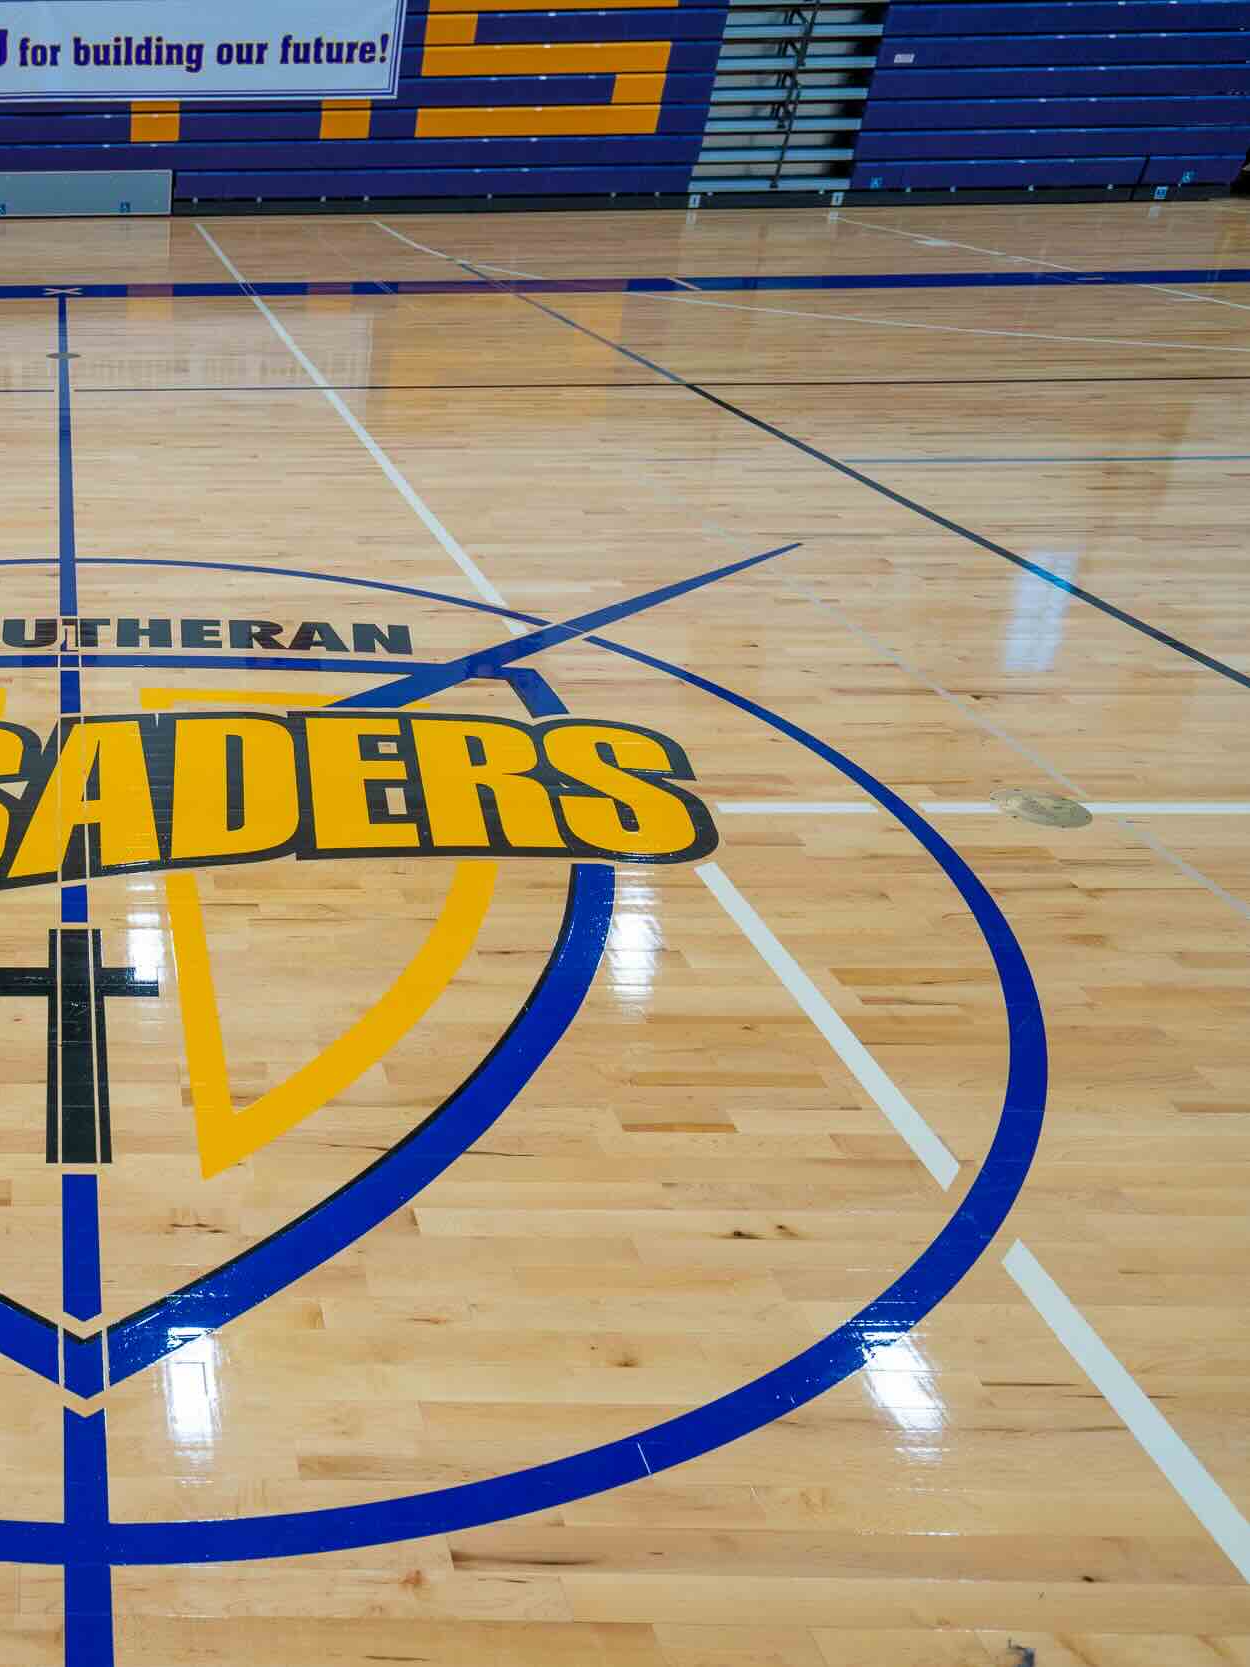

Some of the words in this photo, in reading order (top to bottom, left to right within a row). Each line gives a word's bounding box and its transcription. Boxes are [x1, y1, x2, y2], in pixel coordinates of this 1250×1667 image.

[18, 37, 62, 66] for
[72, 35, 204, 73] building
[215, 39, 267, 66] our
[279, 34, 390, 65] future!
